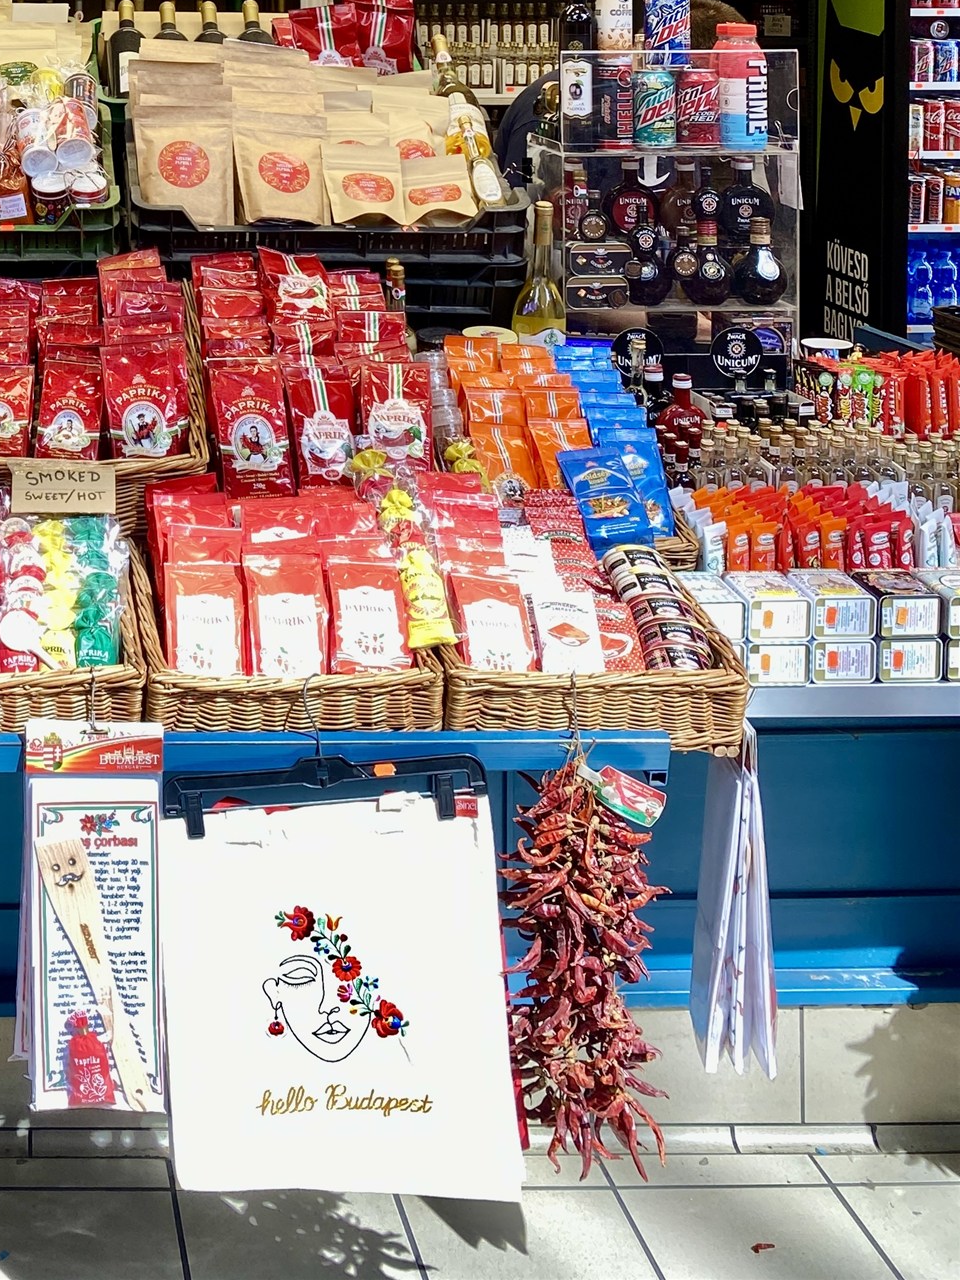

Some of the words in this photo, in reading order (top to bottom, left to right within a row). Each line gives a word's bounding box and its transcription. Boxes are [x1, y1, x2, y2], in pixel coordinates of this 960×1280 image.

[745, 59, 768, 137] PRIME
[619, 197, 648, 206] UNICUM
[731, 197, 760, 206] UNICUM
[827, 238, 869, 282] KÖVESD
[825, 274, 833, 302] A
[835, 276, 869, 318] BELSŐ
[727, 332, 746, 340] ZWACK
[717, 354, 760, 367] UNICUM
[115, 387, 168, 405] PAPRIKA
[49, 398, 90, 416] PAPRIKA
[225, 401, 277, 420] PAPRIKA
[673, 416, 701, 426] UNICUM
[25, 469, 101, 486] SMOKED
[25, 489, 106, 503] SWEET/HOT
[3, 655, 37, 667] PAPRIKA
[99, 753, 160, 766] BUDAPEST
[93, 835, 138, 850] çorbası
[74, 1057, 101, 1067] Paprika
[256, 1085, 319, 1116] hello
[325, 1084, 434, 1117] Budapest
